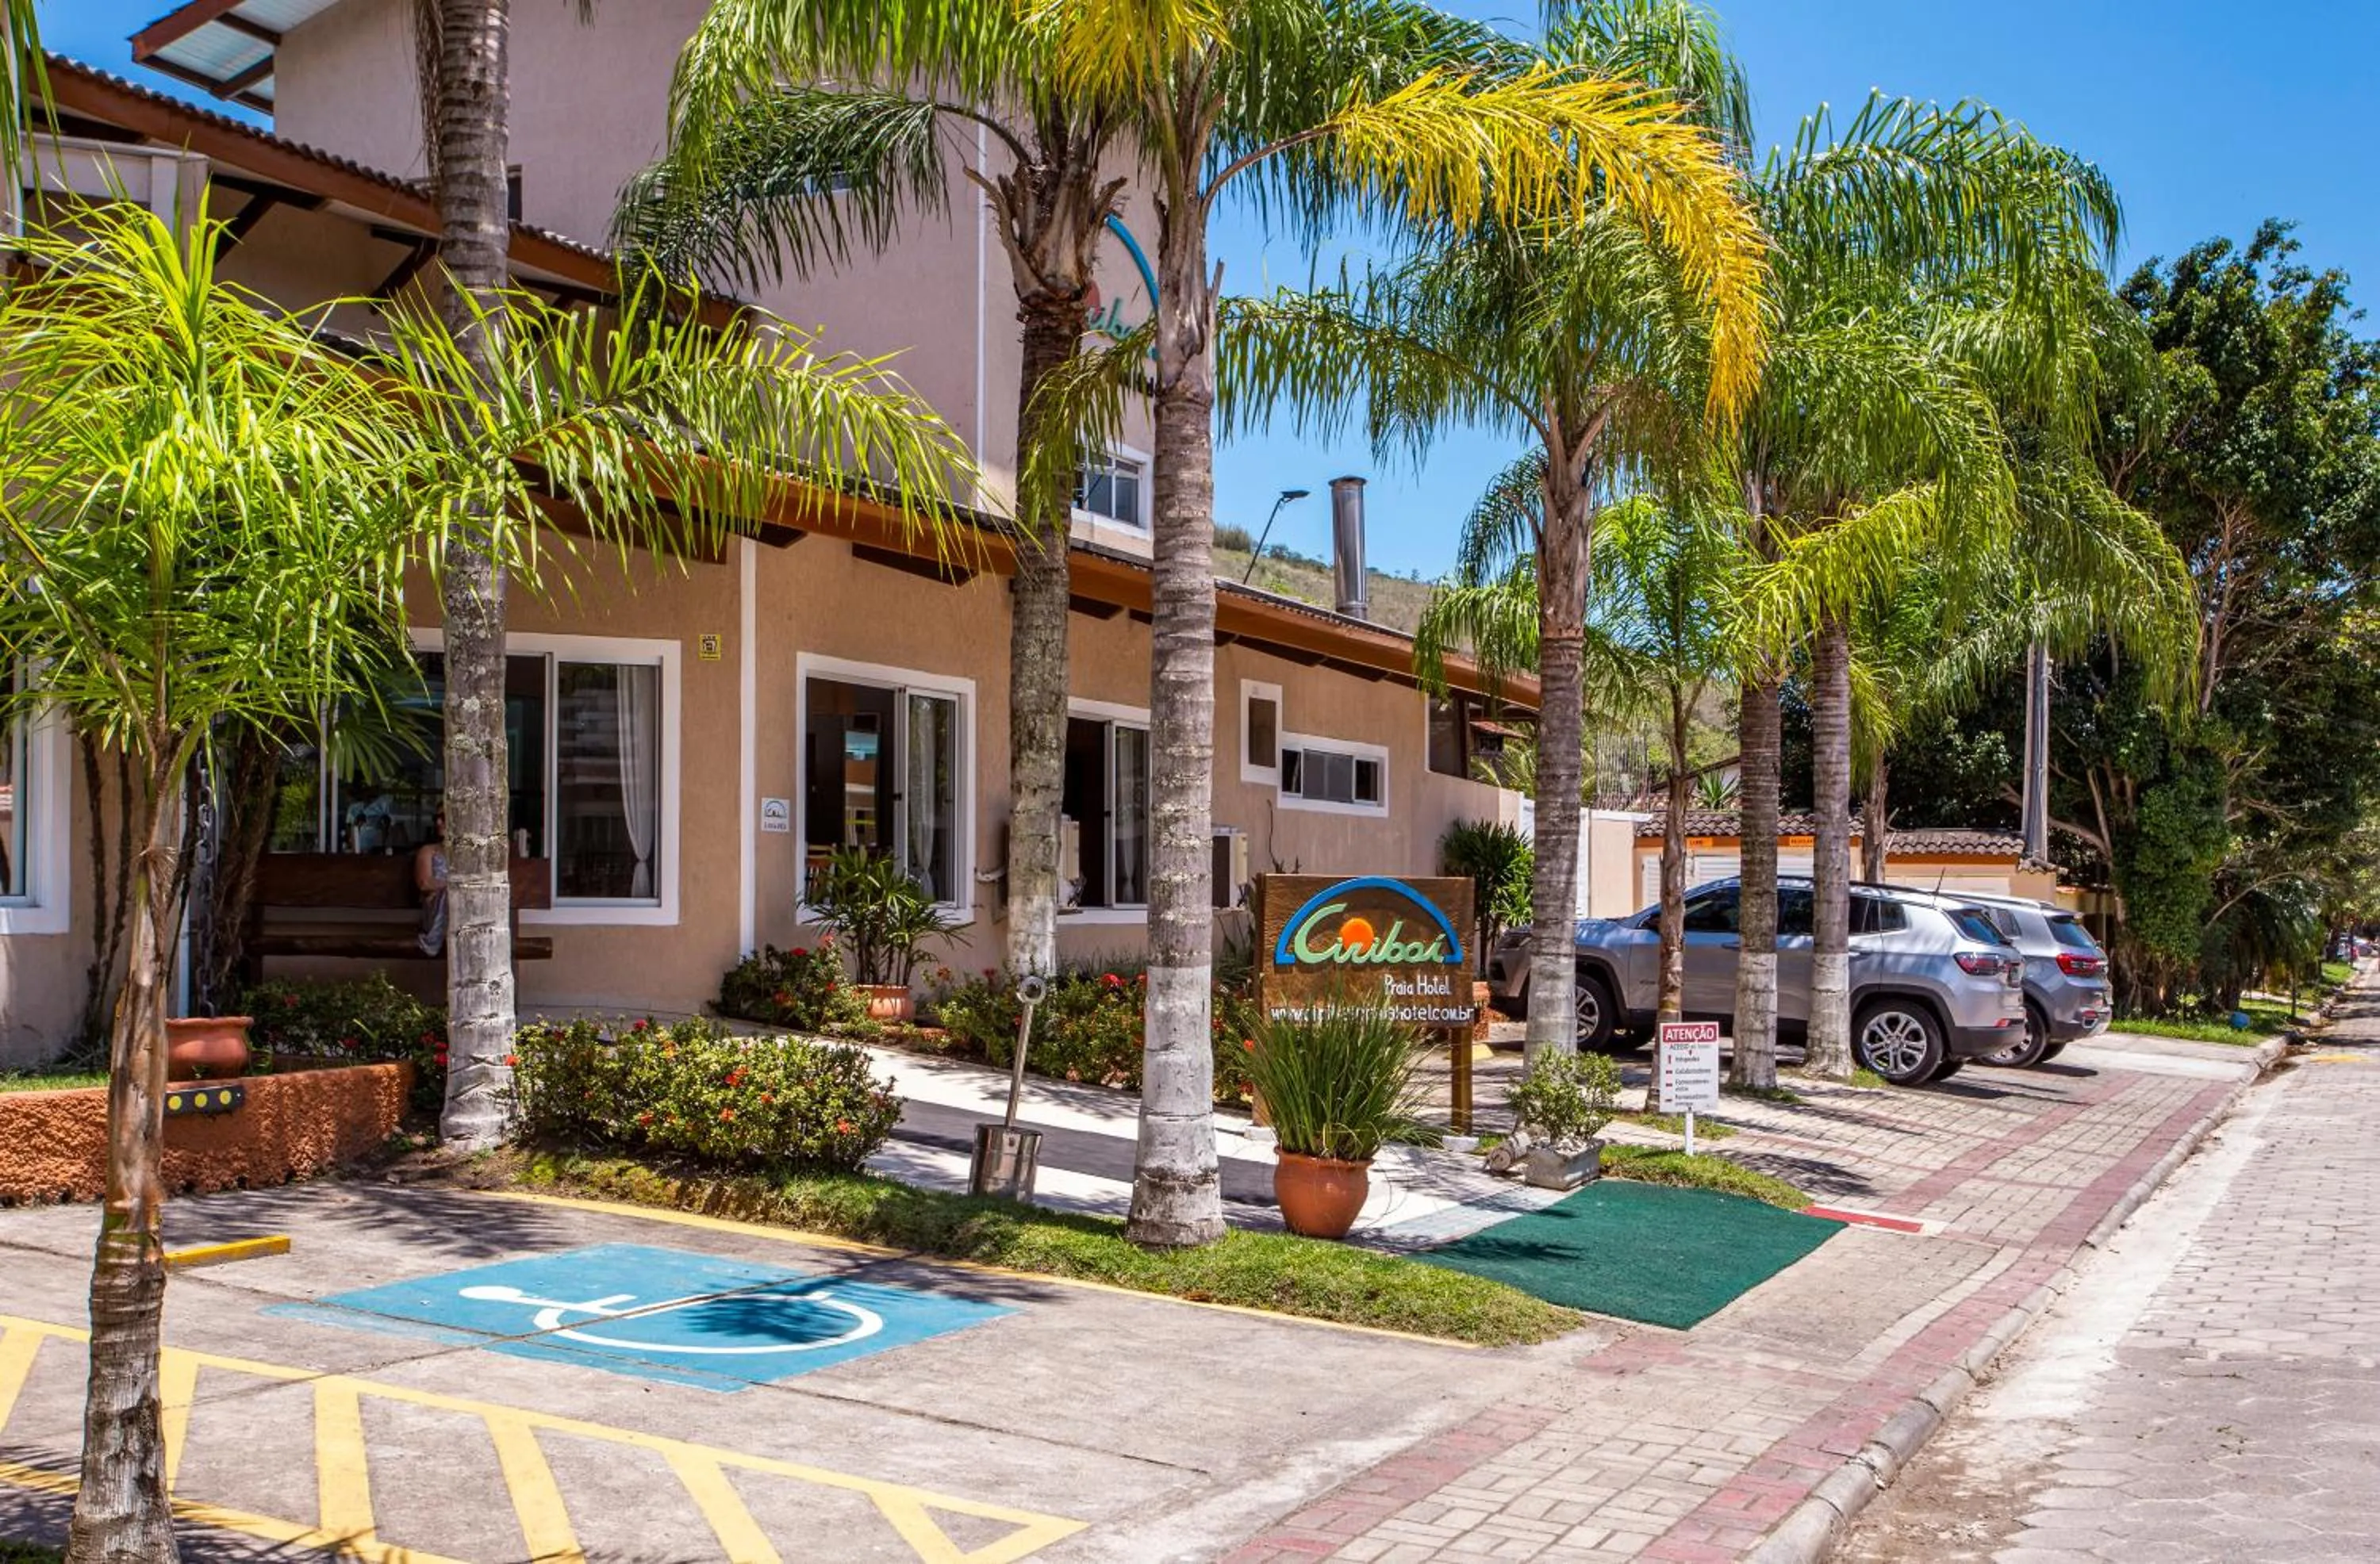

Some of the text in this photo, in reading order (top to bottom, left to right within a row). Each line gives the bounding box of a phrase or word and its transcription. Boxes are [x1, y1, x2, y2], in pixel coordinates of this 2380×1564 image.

[1384, 973, 1452, 995] Praia Hotel
[1664, 1026, 1715, 1042] ATENÇÃO
